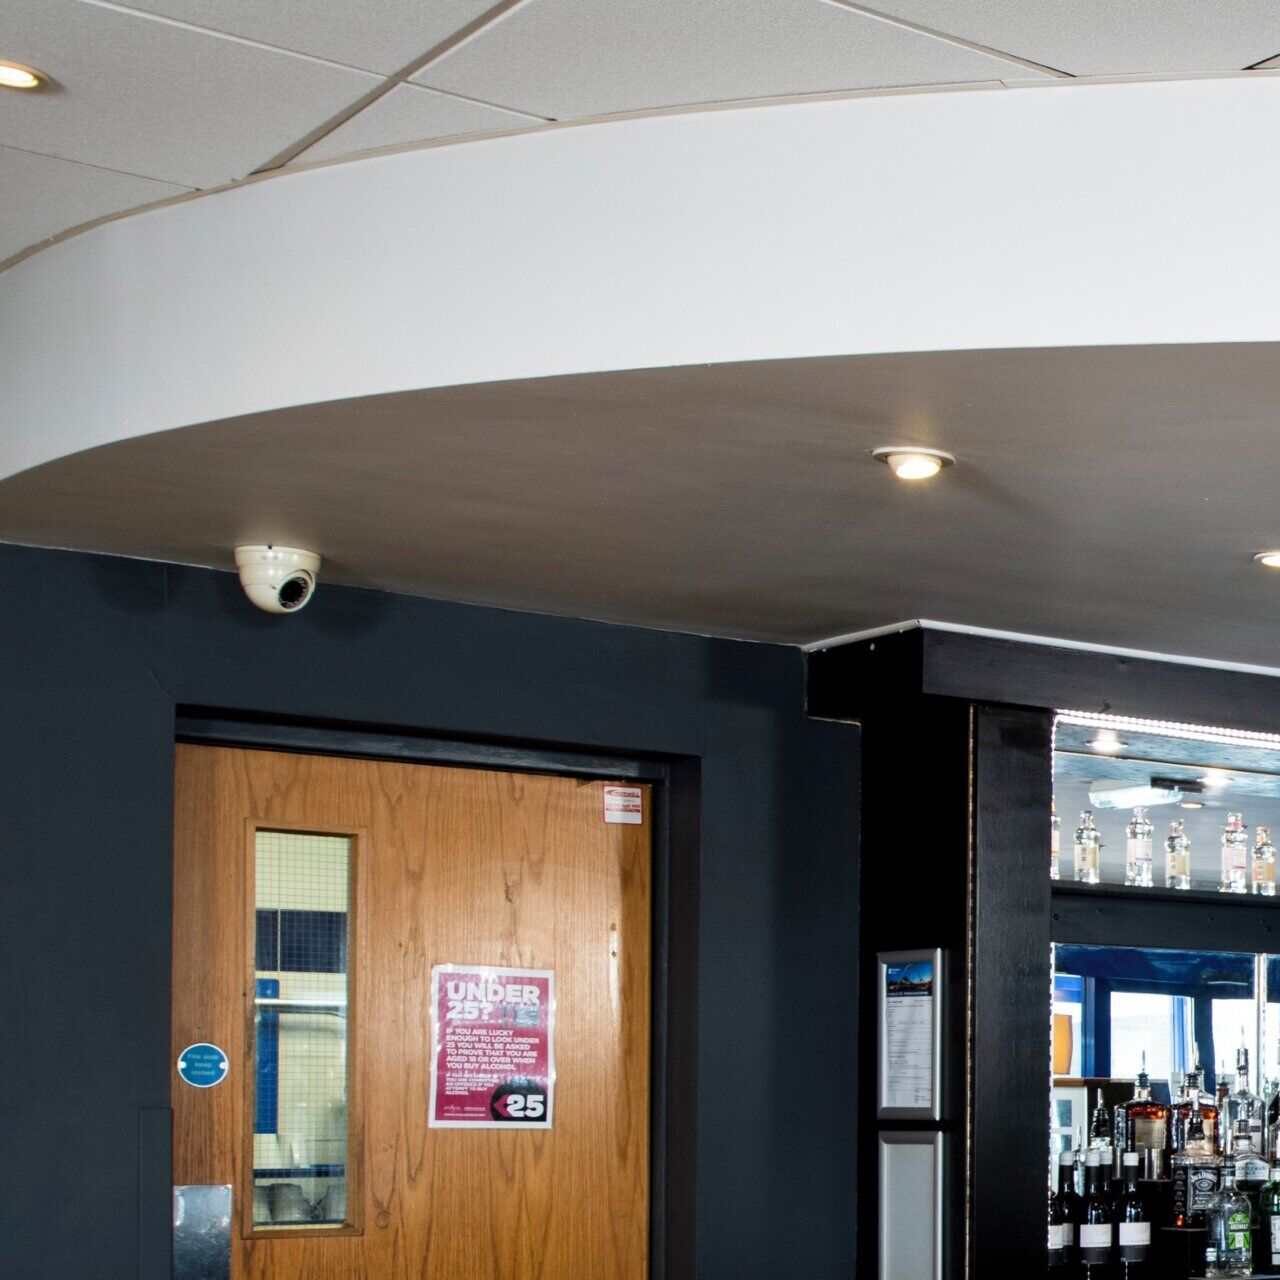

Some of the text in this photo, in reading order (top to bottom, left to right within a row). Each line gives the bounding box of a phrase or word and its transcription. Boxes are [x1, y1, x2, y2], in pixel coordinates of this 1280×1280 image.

[446, 982, 540, 1004] UNDER
[446, 1001, 493, 1020] 25?
[458, 1048, 484, 1056] PROVE
[506, 1093, 545, 1118] 25
